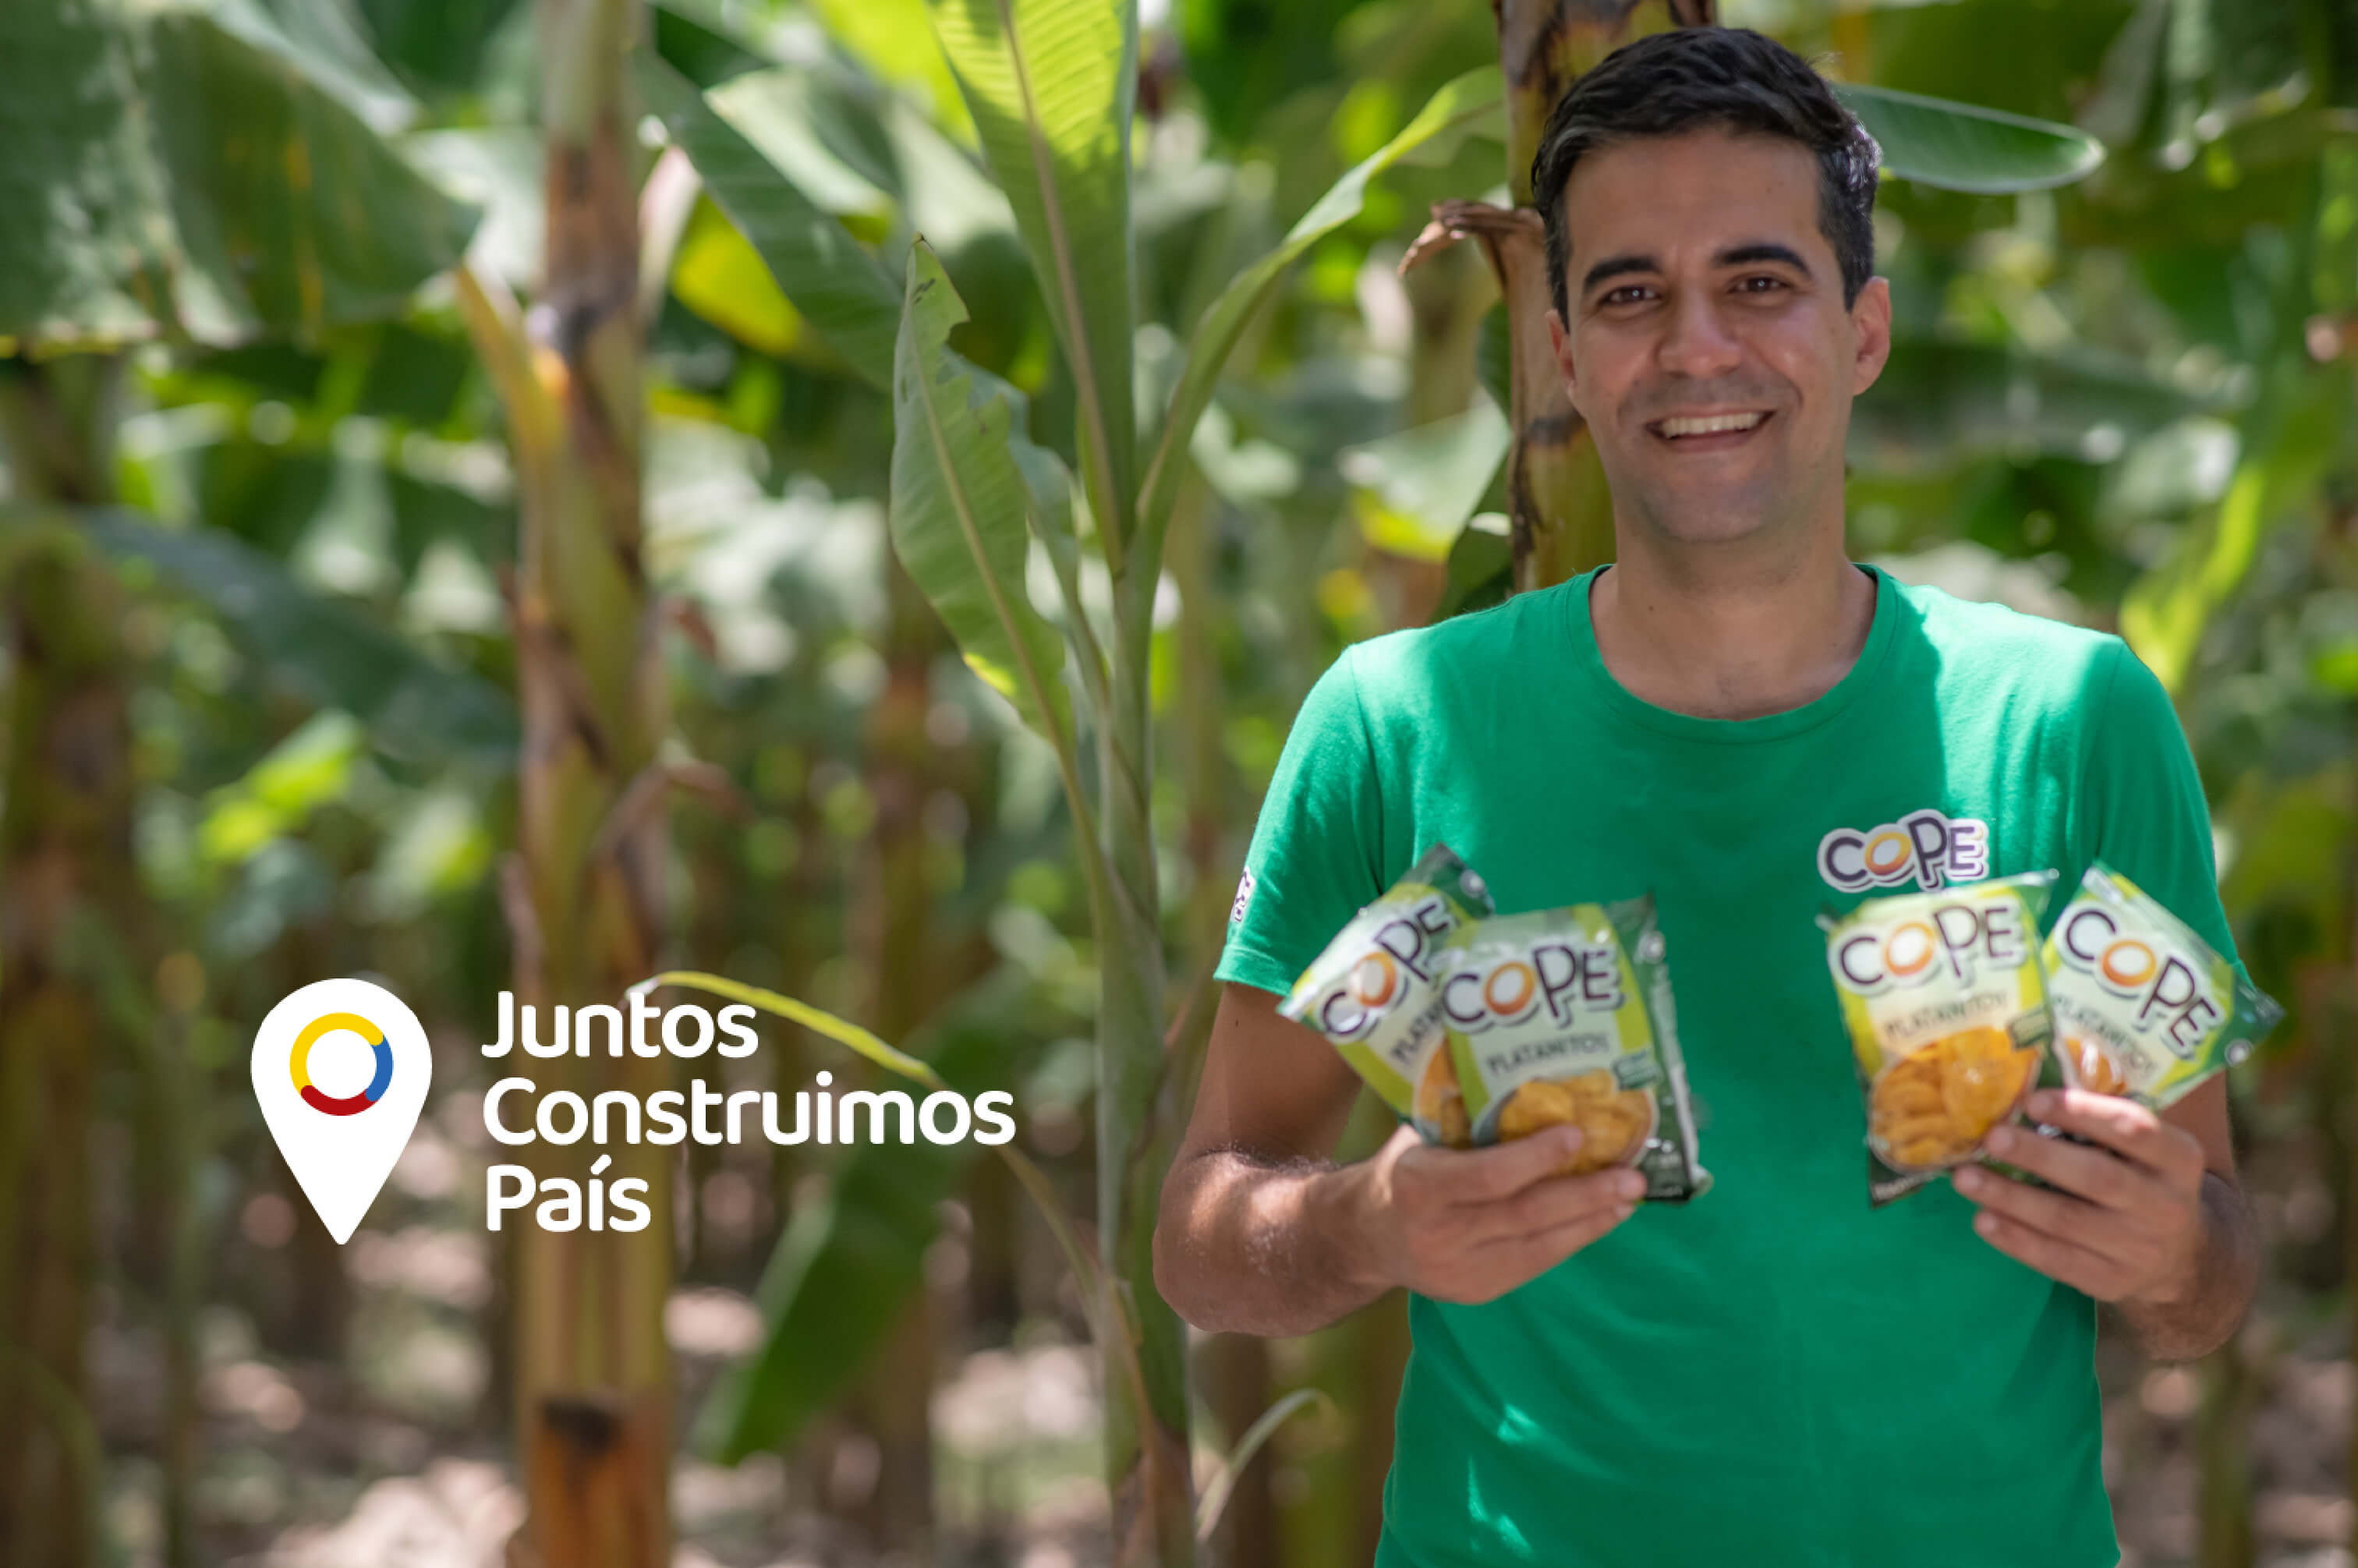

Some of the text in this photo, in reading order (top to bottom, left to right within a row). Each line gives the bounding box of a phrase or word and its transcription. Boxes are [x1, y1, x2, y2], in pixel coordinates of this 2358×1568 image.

[1824, 816, 1976, 882] COPE
[1322, 903, 1449, 1036] COPE
[1445, 945, 1611, 1024] COPE
[1839, 906, 2016, 985] COPE
[2066, 909, 2217, 1047] COPE
